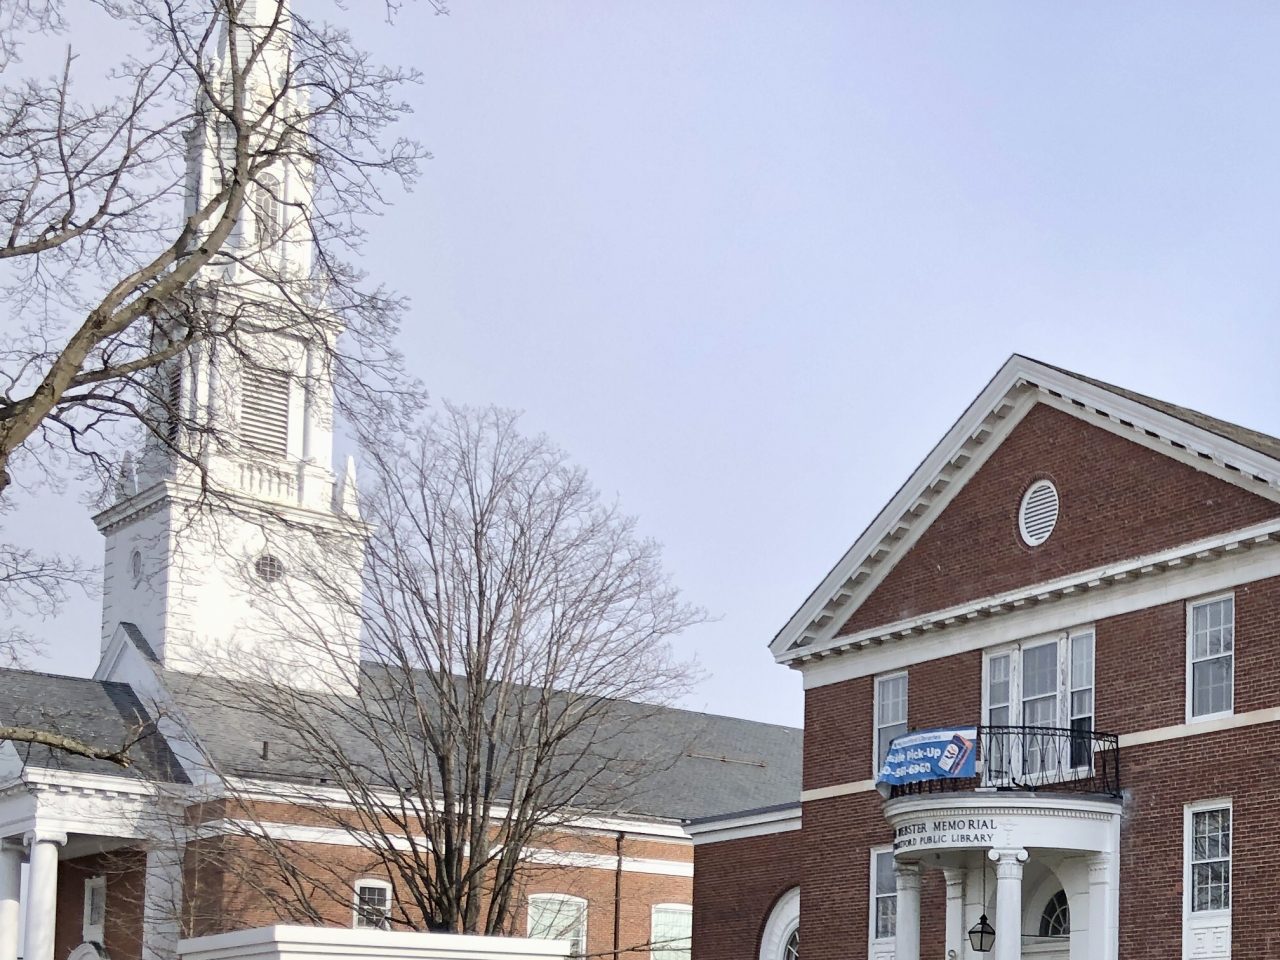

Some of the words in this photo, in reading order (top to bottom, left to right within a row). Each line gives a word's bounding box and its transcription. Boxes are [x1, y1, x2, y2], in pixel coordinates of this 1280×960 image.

[906, 746, 941, 760] Pick-Up
[933, 819, 998, 832] MEMORIAL
[919, 833, 947, 846] PUBLIC
[951, 832, 994, 844] LIBRARY
